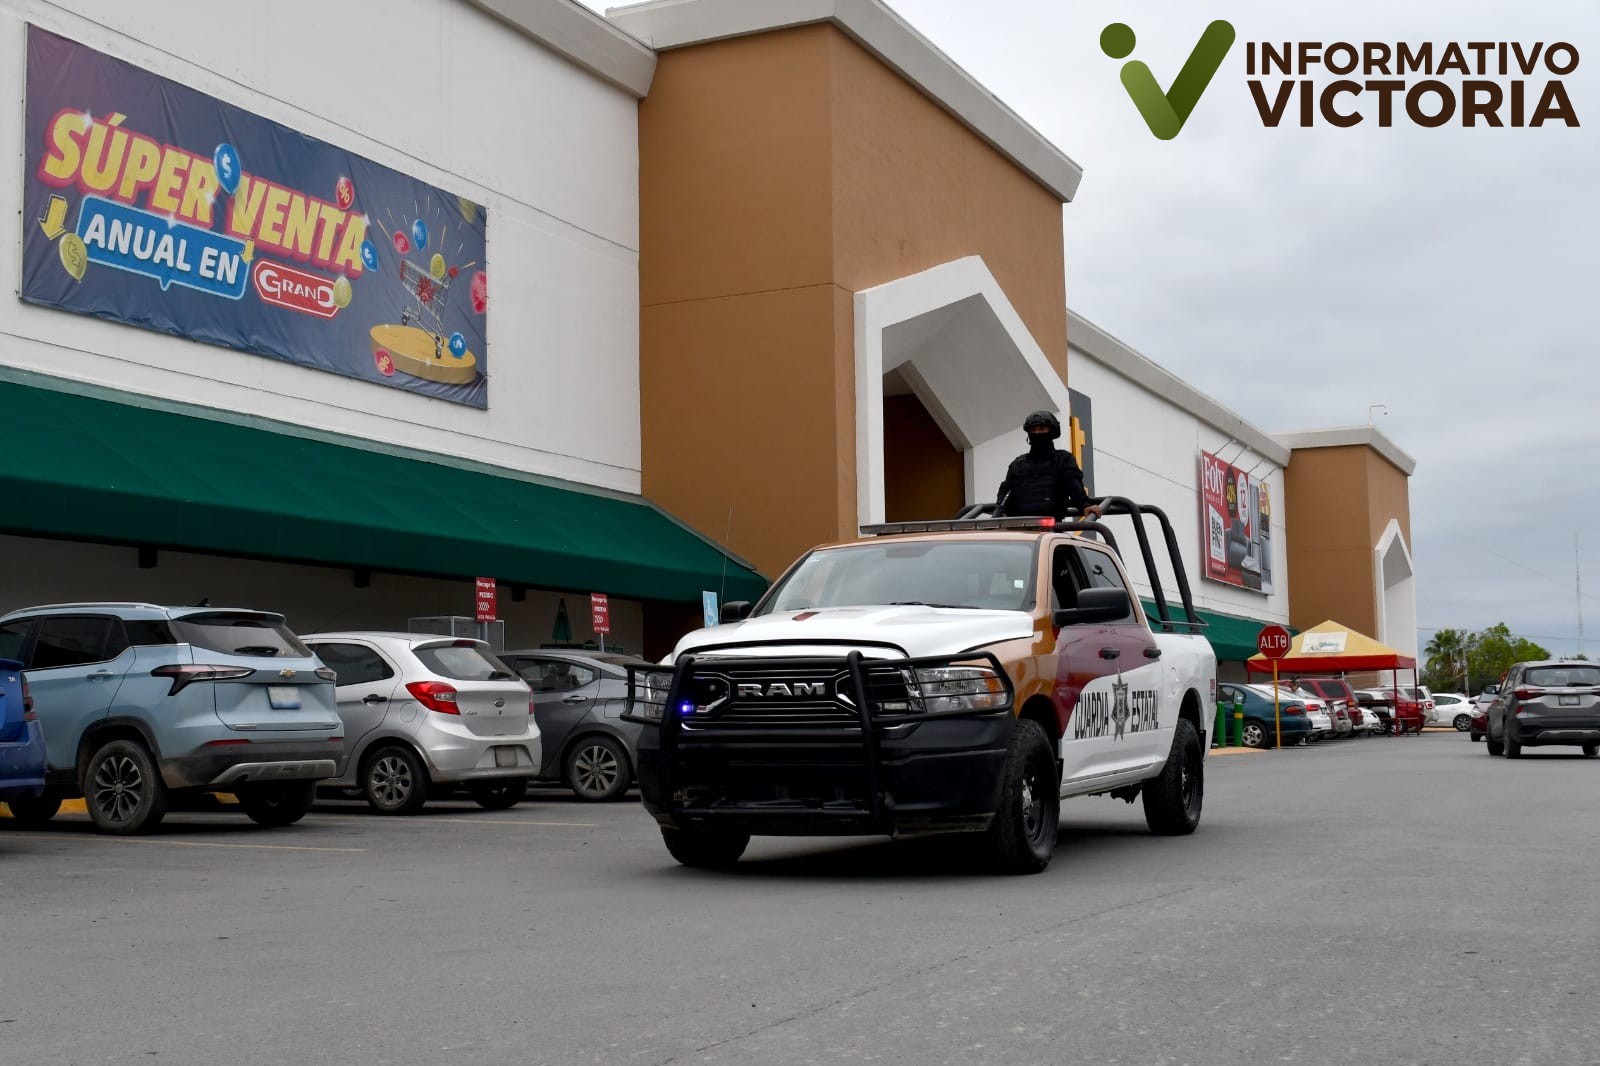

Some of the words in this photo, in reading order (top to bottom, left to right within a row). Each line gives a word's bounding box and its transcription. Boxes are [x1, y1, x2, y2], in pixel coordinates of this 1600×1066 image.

[43, 111, 220, 224] SÚPER
[231, 174, 369, 273] VENTA
[83, 213, 192, 272] ANUAL
[199, 246, 240, 285] EN
[1260, 634, 1287, 649] ALTO
[737, 682, 826, 697] RAM
[1074, 691, 1109, 740] GUARDIA
[1130, 689, 1159, 733] ESTATAL
